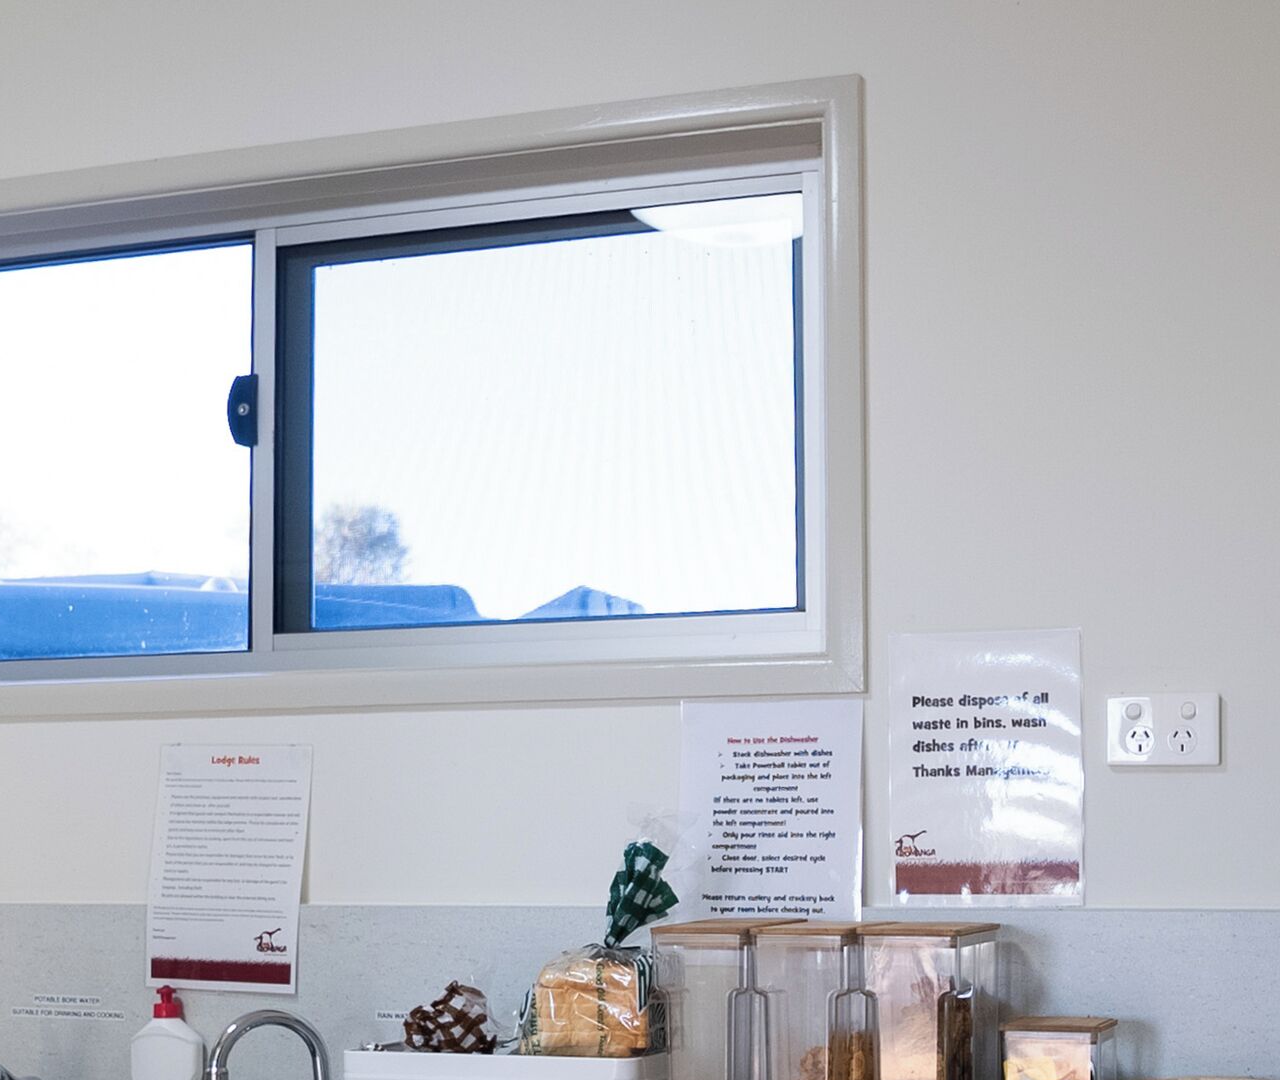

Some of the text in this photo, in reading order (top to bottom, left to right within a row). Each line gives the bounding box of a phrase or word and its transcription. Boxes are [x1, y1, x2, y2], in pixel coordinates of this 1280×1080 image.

[912, 696, 954, 708] Please
[1033, 692, 1049, 704] all
[912, 719, 952, 730] waste
[956, 718, 969, 729] in
[779, 735, 819, 743] Dishwasher
[912, 739, 955, 753] dishes
[960, 738, 990, 752] aft
[753, 750, 792, 758] dishwasher
[793, 749, 809, 757] with
[810, 749, 833, 757] dishes
[211, 755, 261, 767] Lodge Rules
[822, 760, 830, 768] of
[912, 764, 961, 778] Thanks
[721, 774, 755, 783] packaging
[772, 773, 790, 782] place
[807, 772, 818, 780] the
[753, 785, 799, 793] compartment
[712, 808, 738, 816] powder
[795, 808, 819, 816] poured
[722, 831, 739, 840] Only
[740, 832, 756, 840] pour
[806, 830, 818, 838] the
[819, 830, 836, 841] right
[809, 854, 826, 864] cycle
[711, 865, 733, 873] before
[734, 866, 763, 875] pressing
[747, 895, 771, 904] cutlery
[788, 894, 818, 904] crockery
[819, 894, 835, 902] back
[719, 906, 736, 915] your
[757, 905, 779, 913] before
[780, 906, 810, 916] checking
[596, 963, 606, 987] Good
[34, 995, 60, 1003] POTABLE
[12, 1008, 39, 1016] SUITABLE
